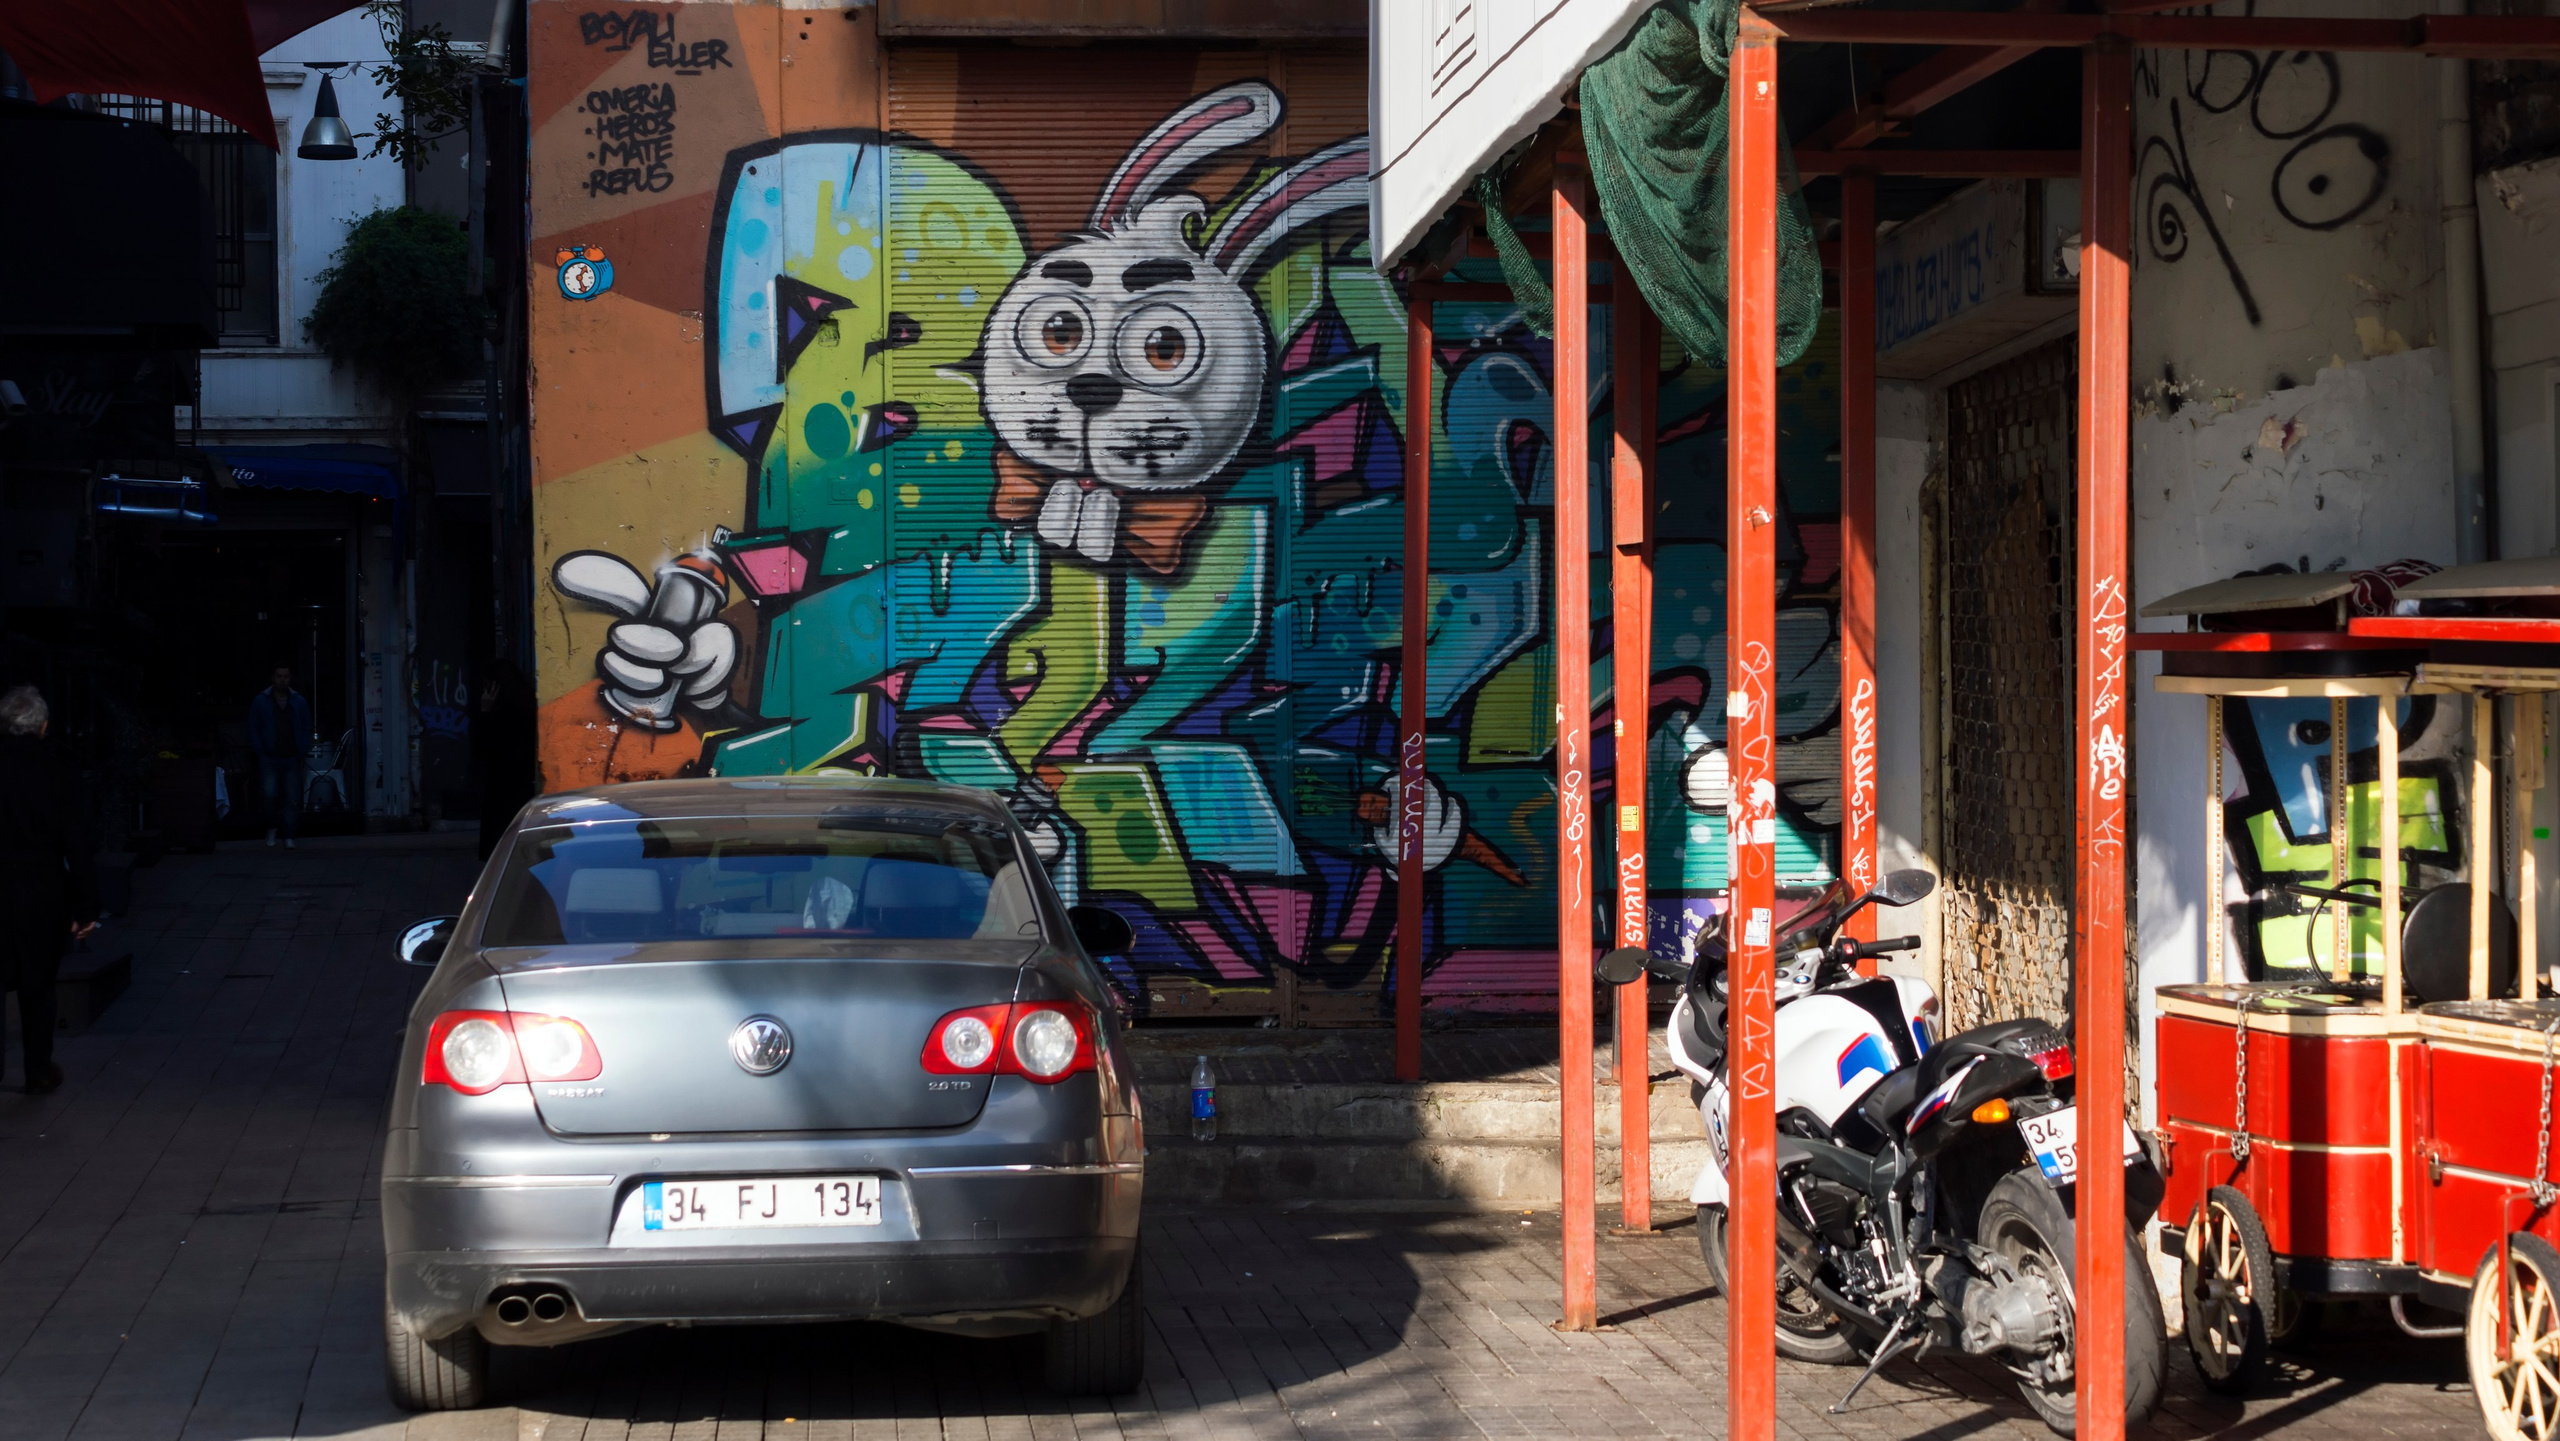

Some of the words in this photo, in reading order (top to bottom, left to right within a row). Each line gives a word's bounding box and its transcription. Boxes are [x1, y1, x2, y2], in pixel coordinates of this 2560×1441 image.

[648, 39, 733, 69] ELLER
[599, 134, 673, 167] MATE
[667, 1187, 706, 1222] 34
[738, 1184, 777, 1219] FJ
[814, 1181, 873, 1217] 134
